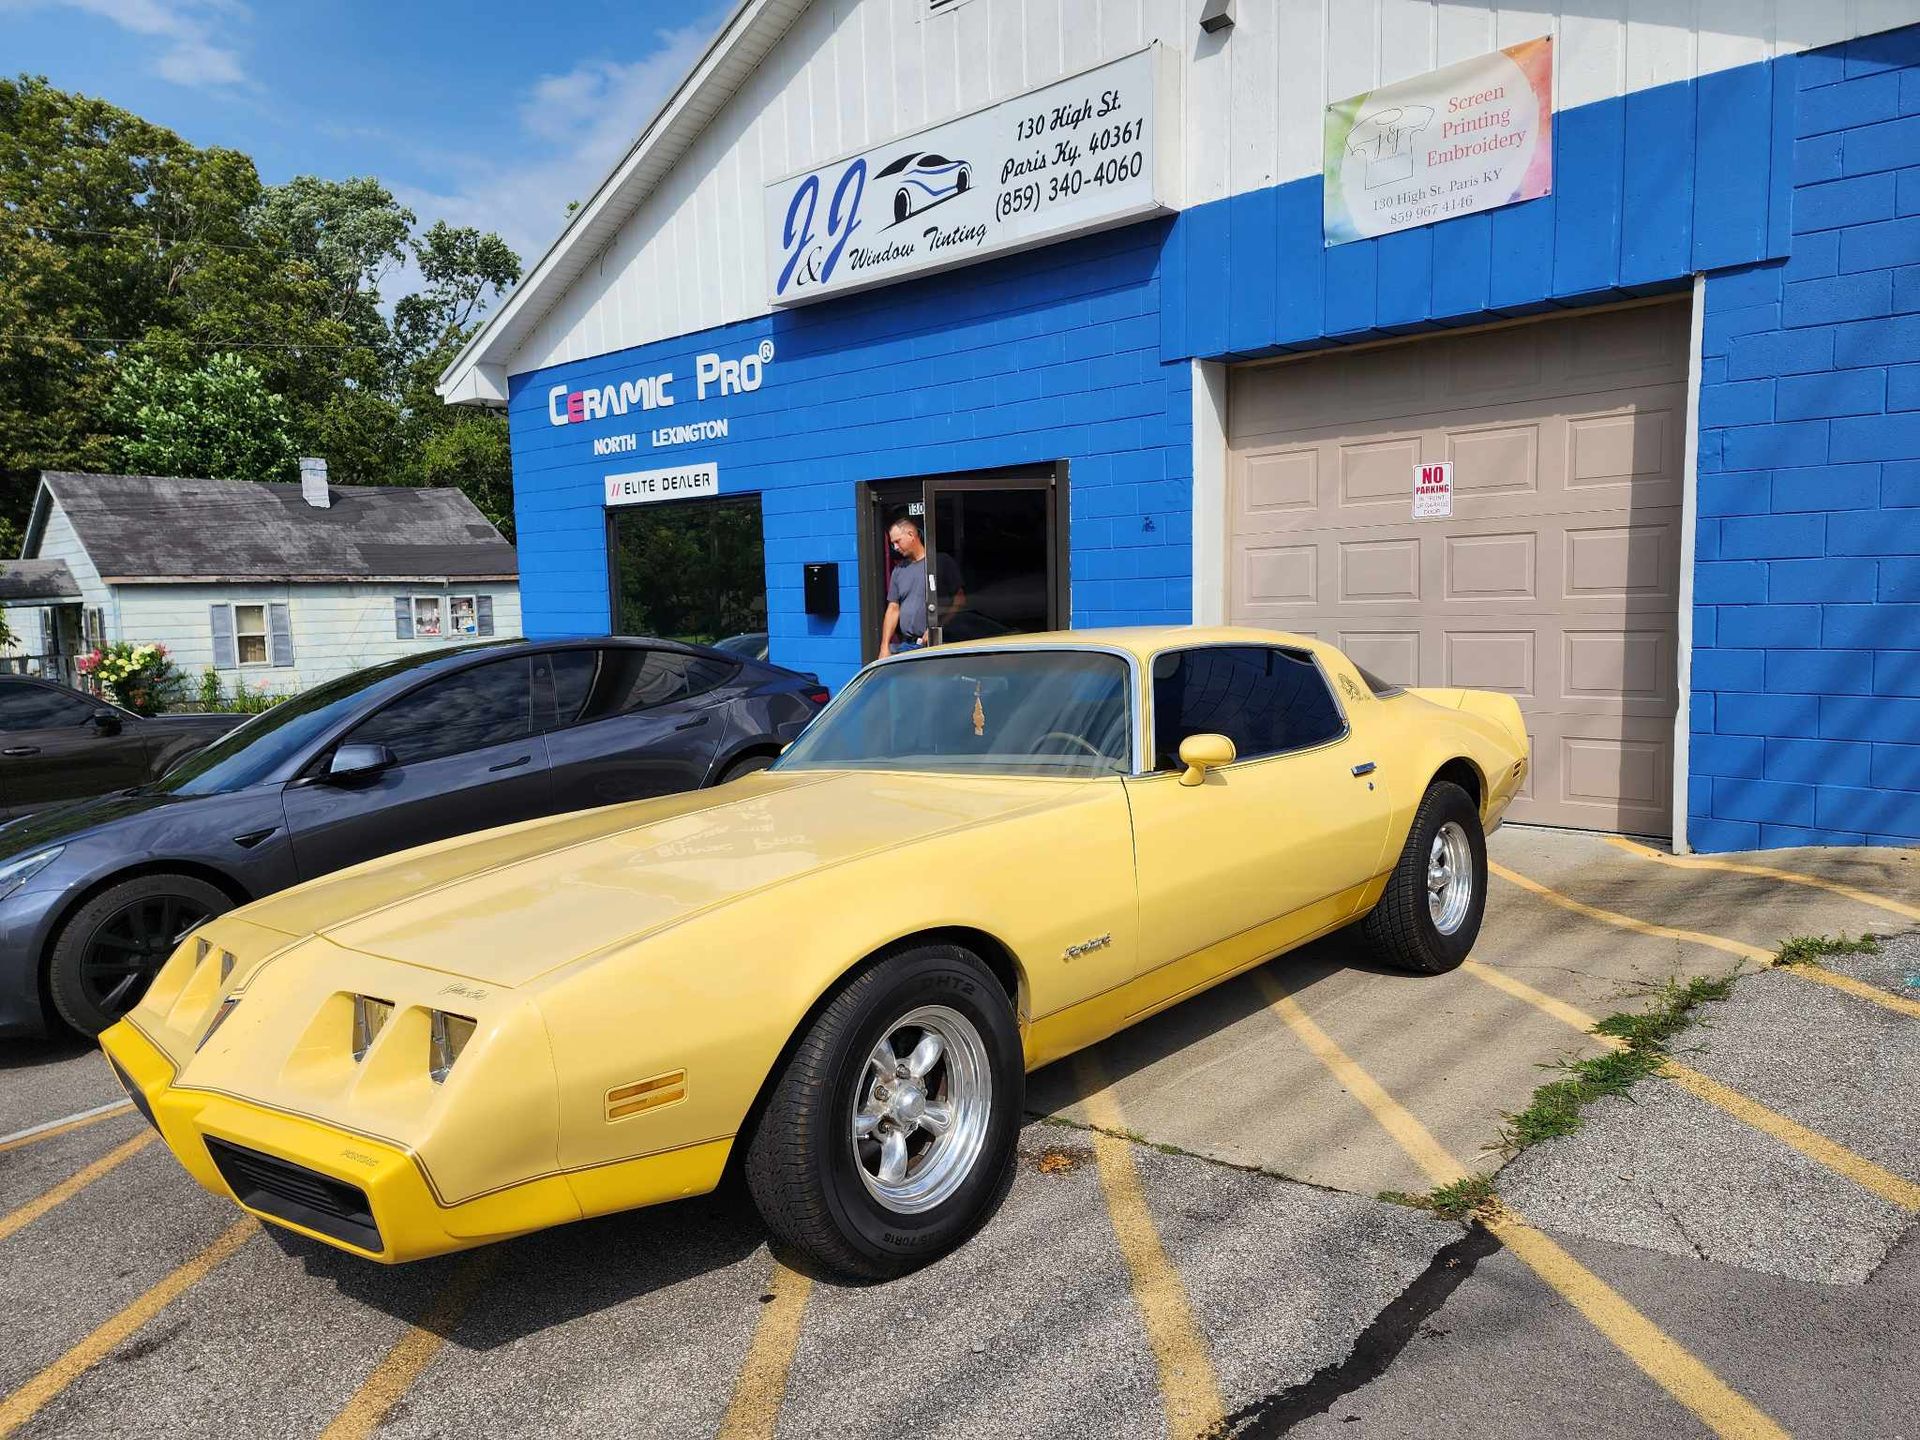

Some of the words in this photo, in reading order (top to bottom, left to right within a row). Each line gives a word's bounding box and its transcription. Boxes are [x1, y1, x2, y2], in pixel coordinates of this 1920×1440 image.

[1017, 114, 1045, 141] 130
[1049, 98, 1092, 131] High
[1097, 89, 1121, 117] St.
[1448, 86, 1504, 113] Screen
[1442, 107, 1511, 139] Printing
[1001, 149, 1047, 184] Paris
[1051, 140, 1081, 167] Ky.
[1089, 118, 1143, 155] 40361
[1427, 130, 1527, 167] Embroidery
[996, 182, 1040, 222] (859)
[1048, 151, 1143, 202] 340-4060
[1374, 197, 1393, 211] 130
[1397, 188, 1426, 205] High
[1430, 184, 1445, 197] St.
[1449, 176, 1479, 191] Paris
[1483, 168, 1503, 183] KY
[1390, 210, 1413, 225] 859
[1416, 204, 1439, 219] 967
[849, 241, 915, 270] Window
[923, 223, 987, 251] Tinting
[594, 434, 637, 456] NORTH
[652, 419, 729, 447] LEXINGTON
[624, 479, 655, 495] ELITE
[662, 473, 710, 491] DEALER
[1416, 484, 1449, 495] PARKING
[1422, 466, 1444, 485] NO
